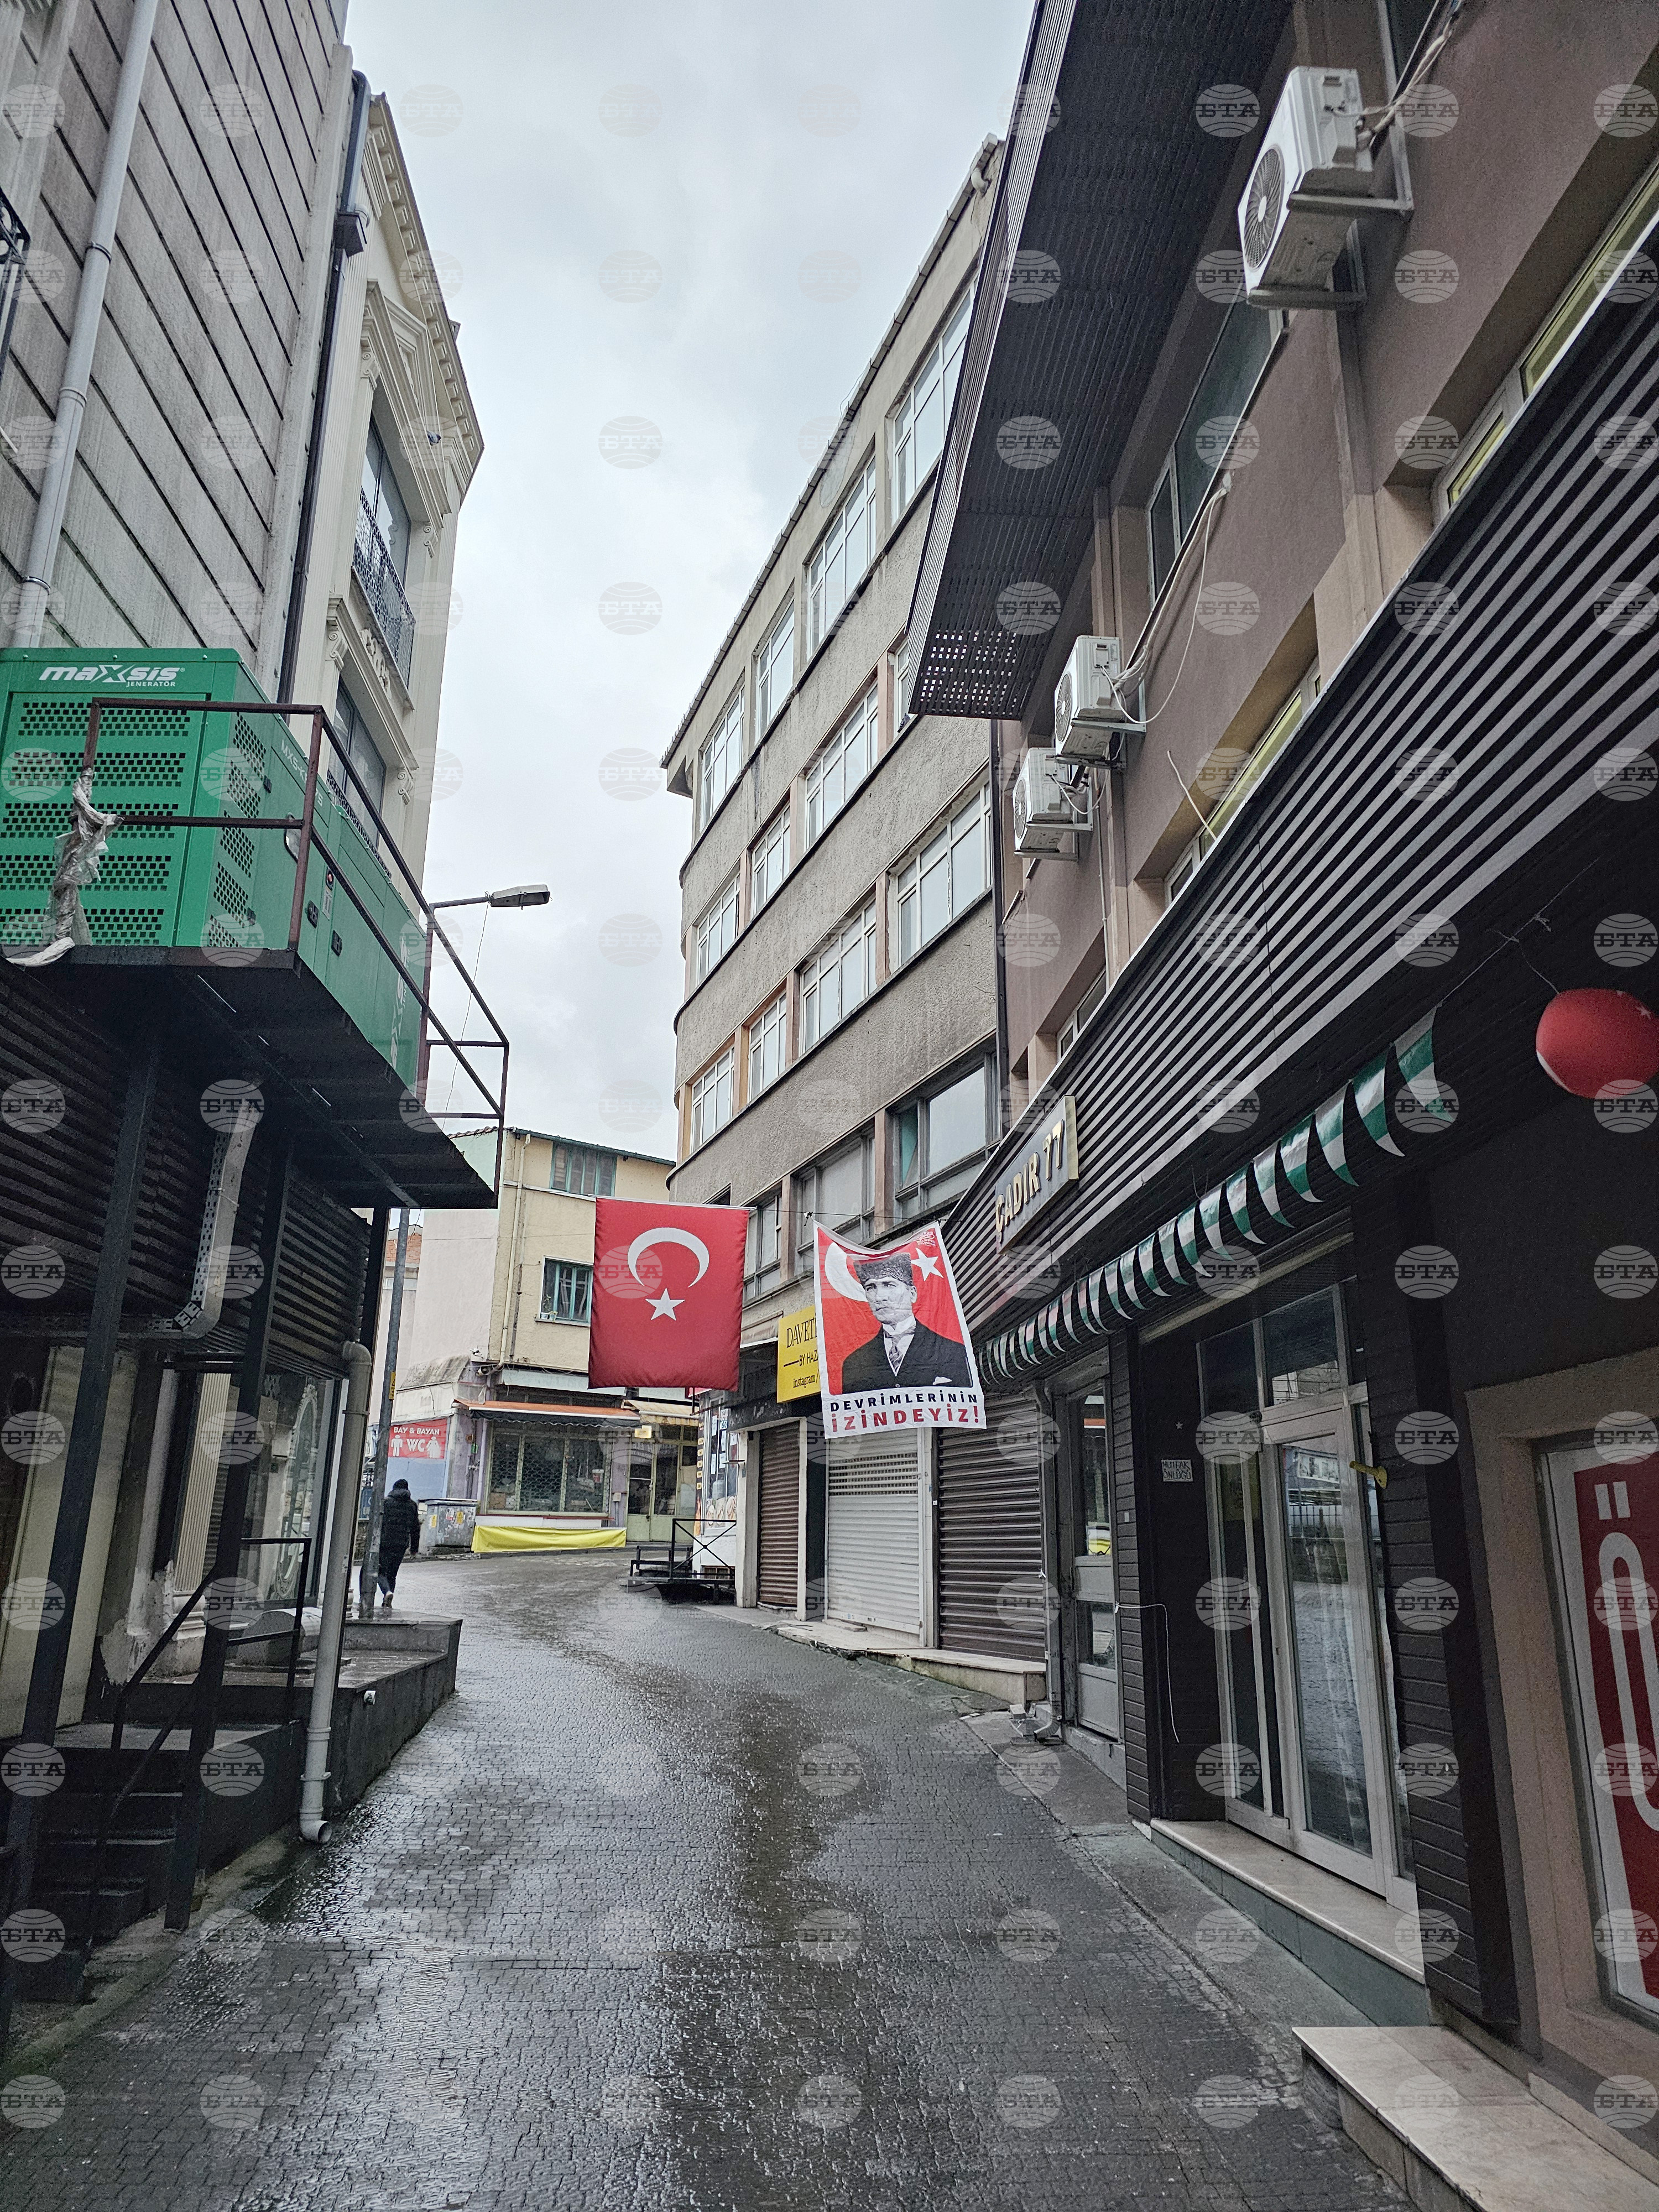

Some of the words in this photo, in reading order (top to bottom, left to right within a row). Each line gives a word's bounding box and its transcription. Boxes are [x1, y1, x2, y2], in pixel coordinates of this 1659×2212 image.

[126, 680, 176, 688] JENERATÖR
[995, 1152, 1041, 1243] ÇADIR
[799, 1354, 805, 1366] BY
[830, 1390, 978, 1412] DEVRİMLERİNİN
[832, 1404, 979, 1432] İZİNDEYİZ!
[406, 1439, 426, 1452] WC
